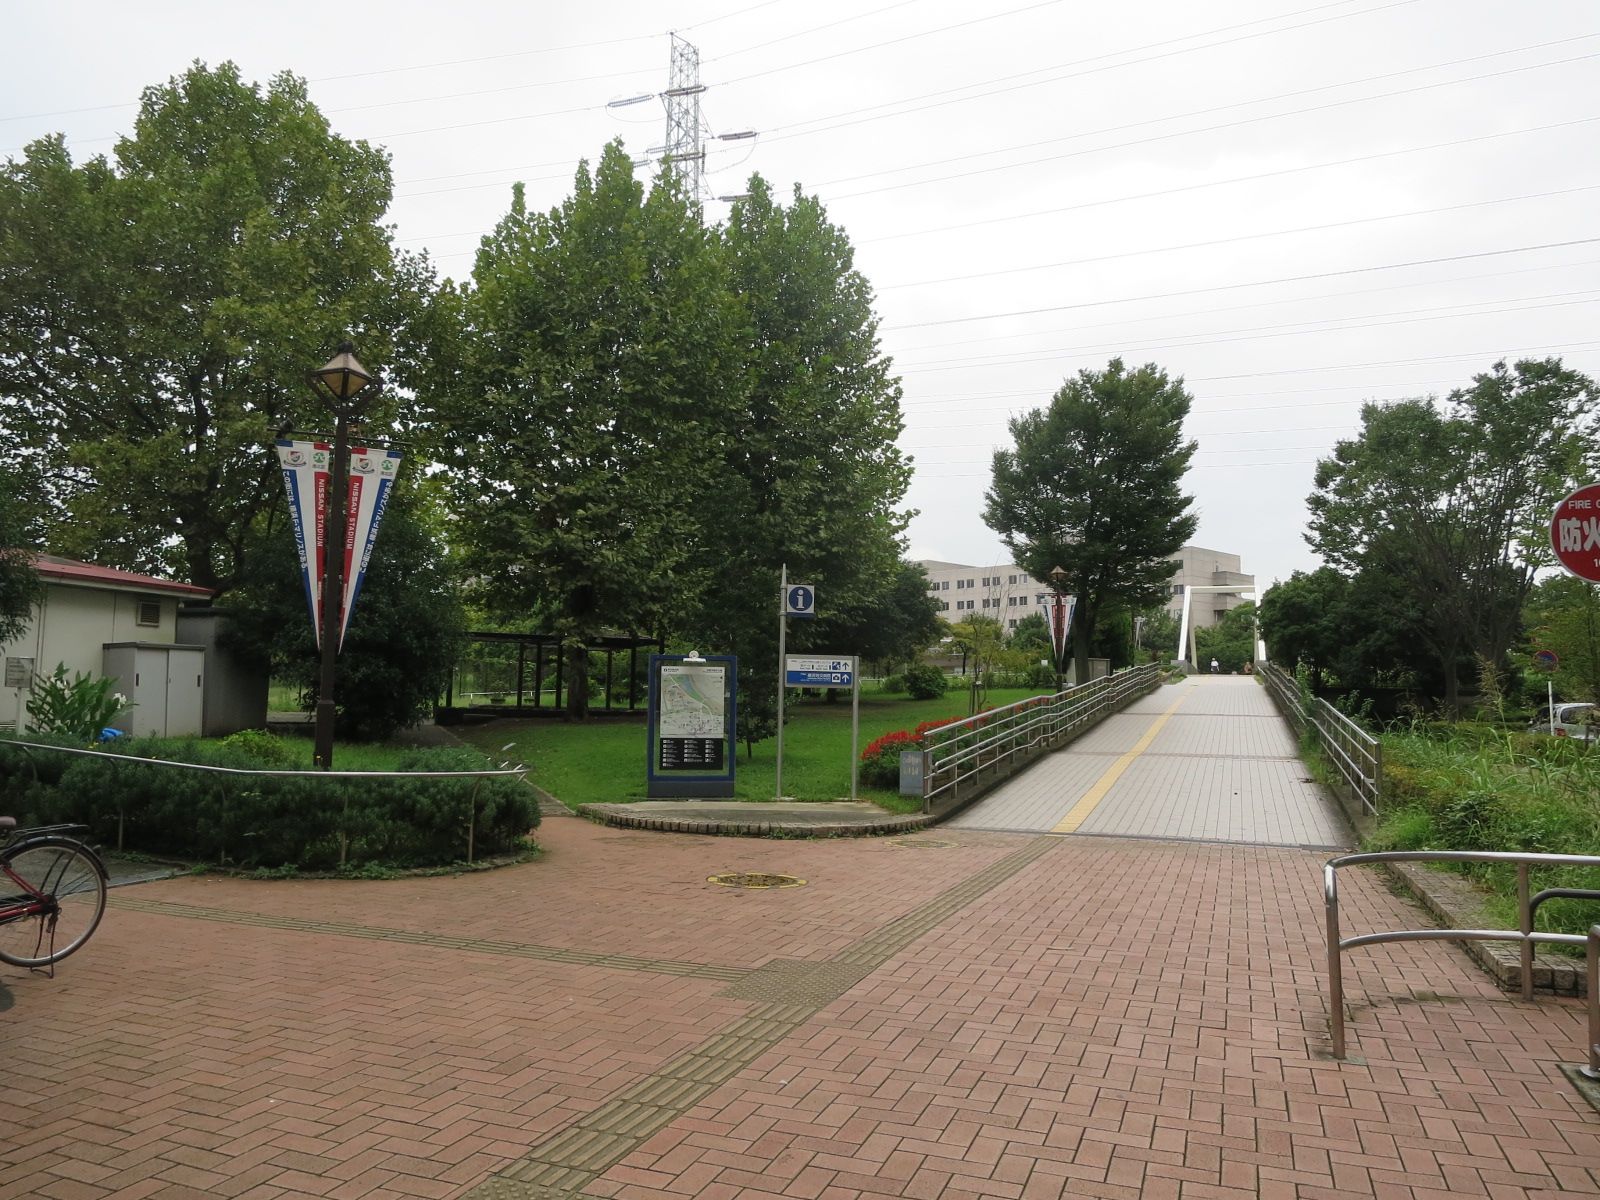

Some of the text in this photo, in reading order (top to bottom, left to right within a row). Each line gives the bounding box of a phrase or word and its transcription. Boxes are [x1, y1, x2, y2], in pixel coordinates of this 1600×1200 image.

[346, 482, 359, 549] NISSAN STADIUM
[1569, 500, 1592, 509] FIRE
